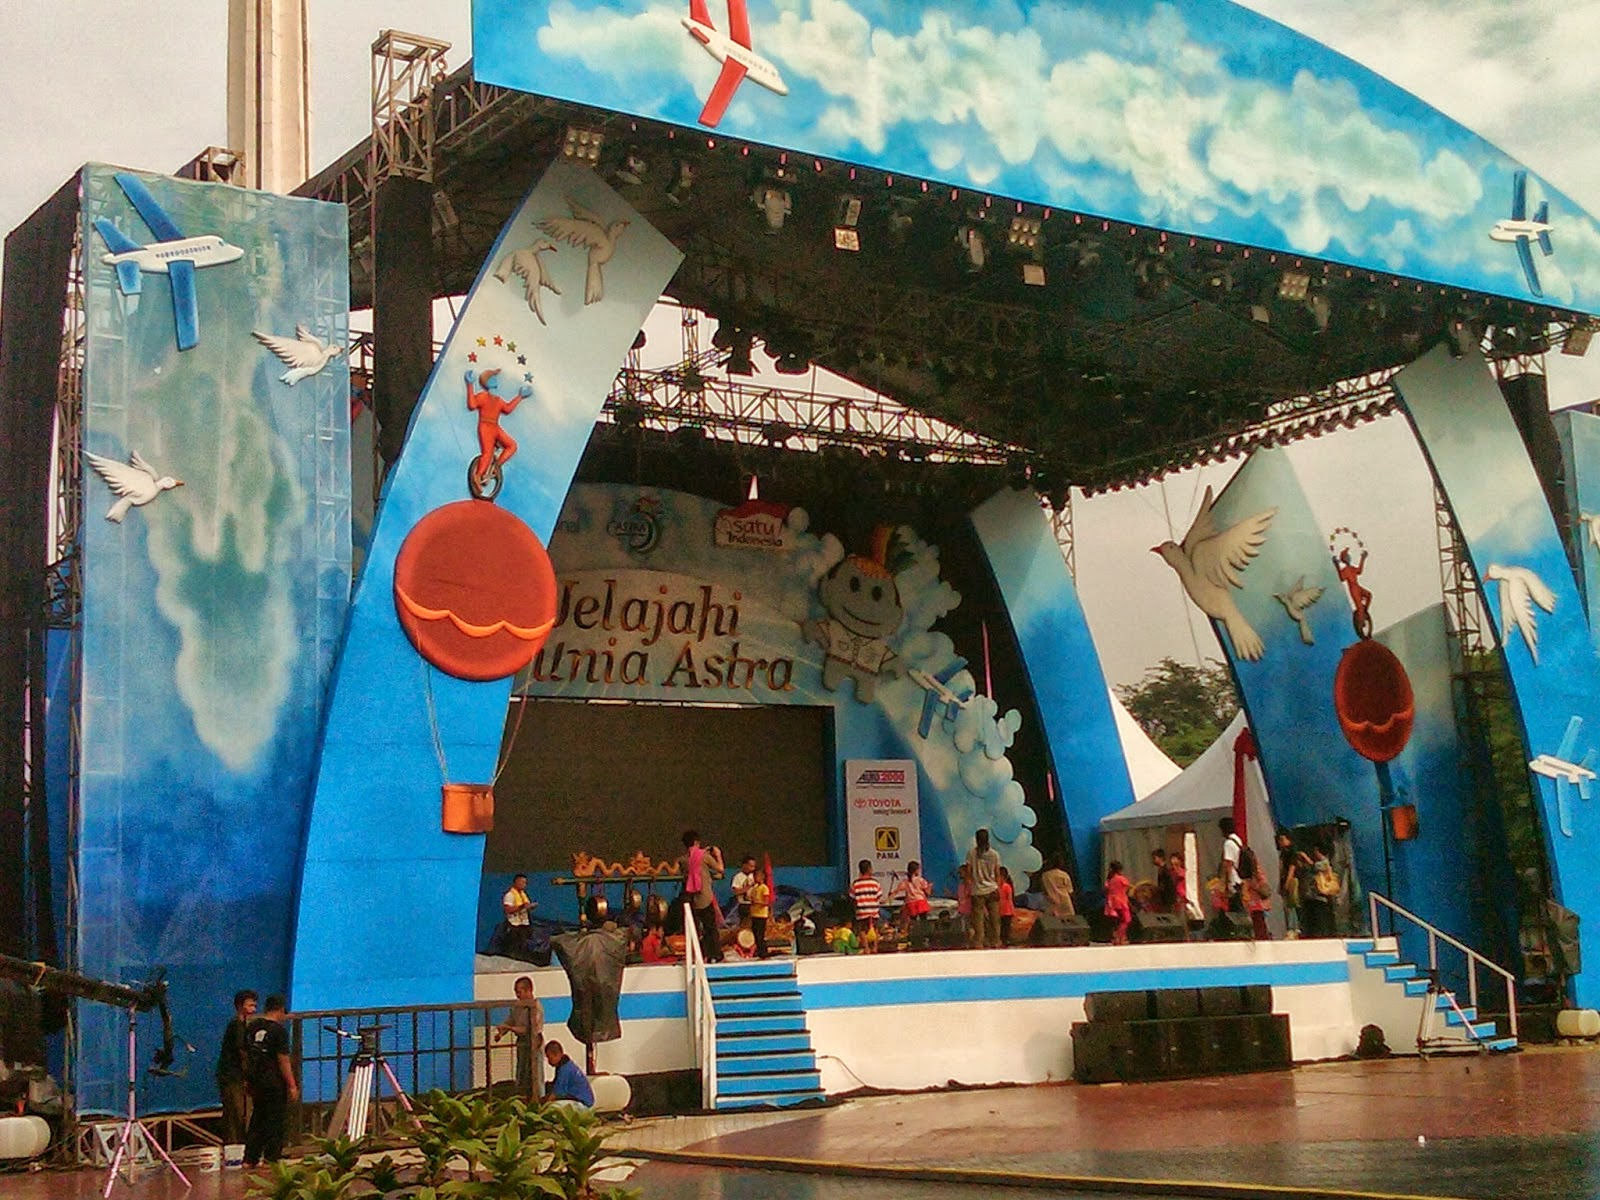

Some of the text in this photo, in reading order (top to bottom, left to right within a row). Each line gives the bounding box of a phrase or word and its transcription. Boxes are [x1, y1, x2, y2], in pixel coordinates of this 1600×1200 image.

[552, 579, 742, 646] Jelajahi
[533, 637, 795, 691] unia Astra
[868, 798, 901, 808] TOYOTA
[877, 852, 900, 860] PAMA
